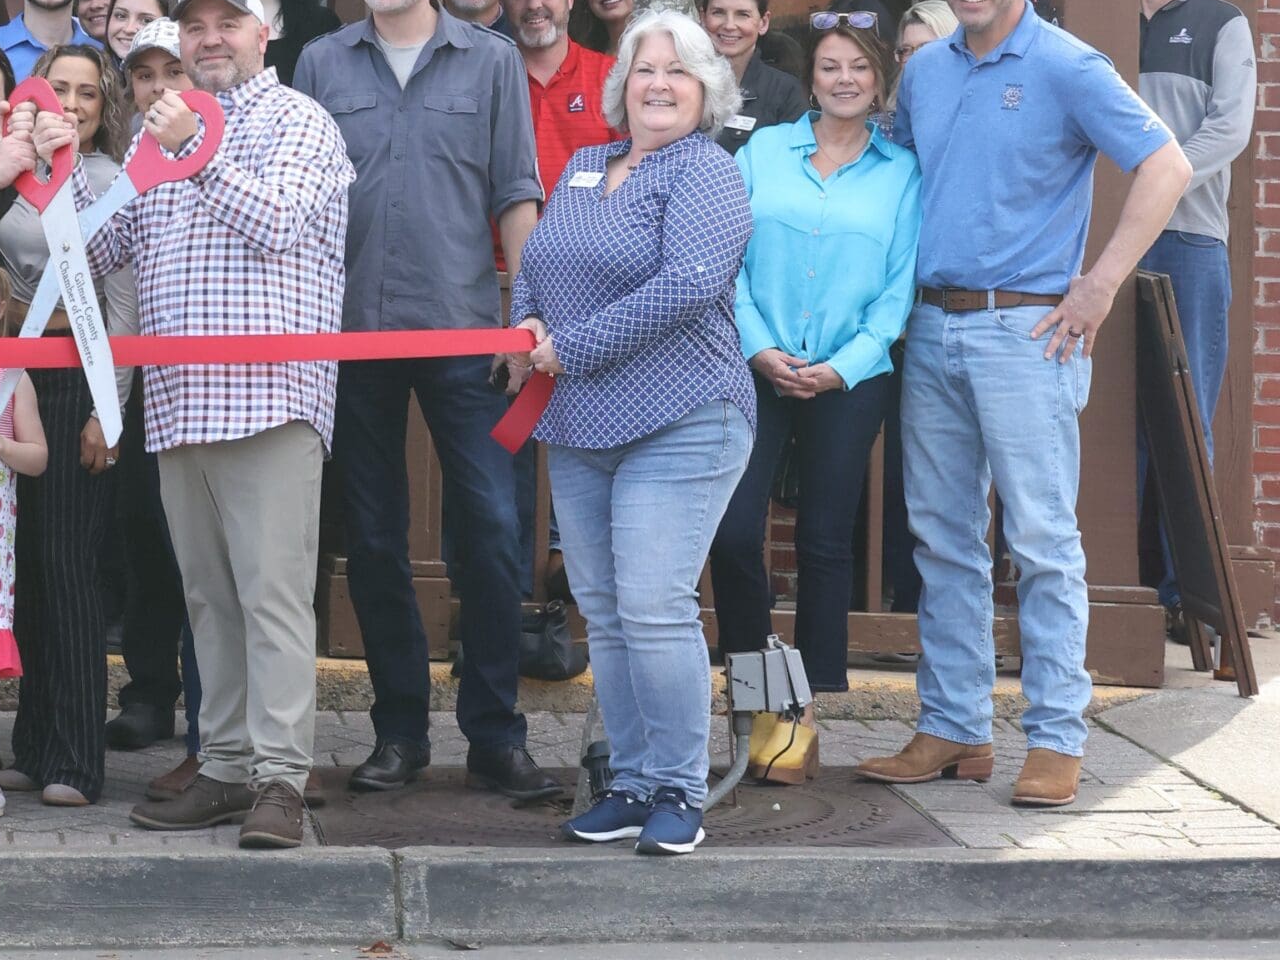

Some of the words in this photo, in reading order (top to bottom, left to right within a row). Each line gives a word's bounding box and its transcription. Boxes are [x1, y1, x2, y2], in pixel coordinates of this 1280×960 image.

[60, 260, 75, 303] Chamber
[72, 304, 81, 315] of
[74, 272, 88, 305] Gilmer
[84, 306, 98, 341] County
[75, 315, 94, 367] Commerce
